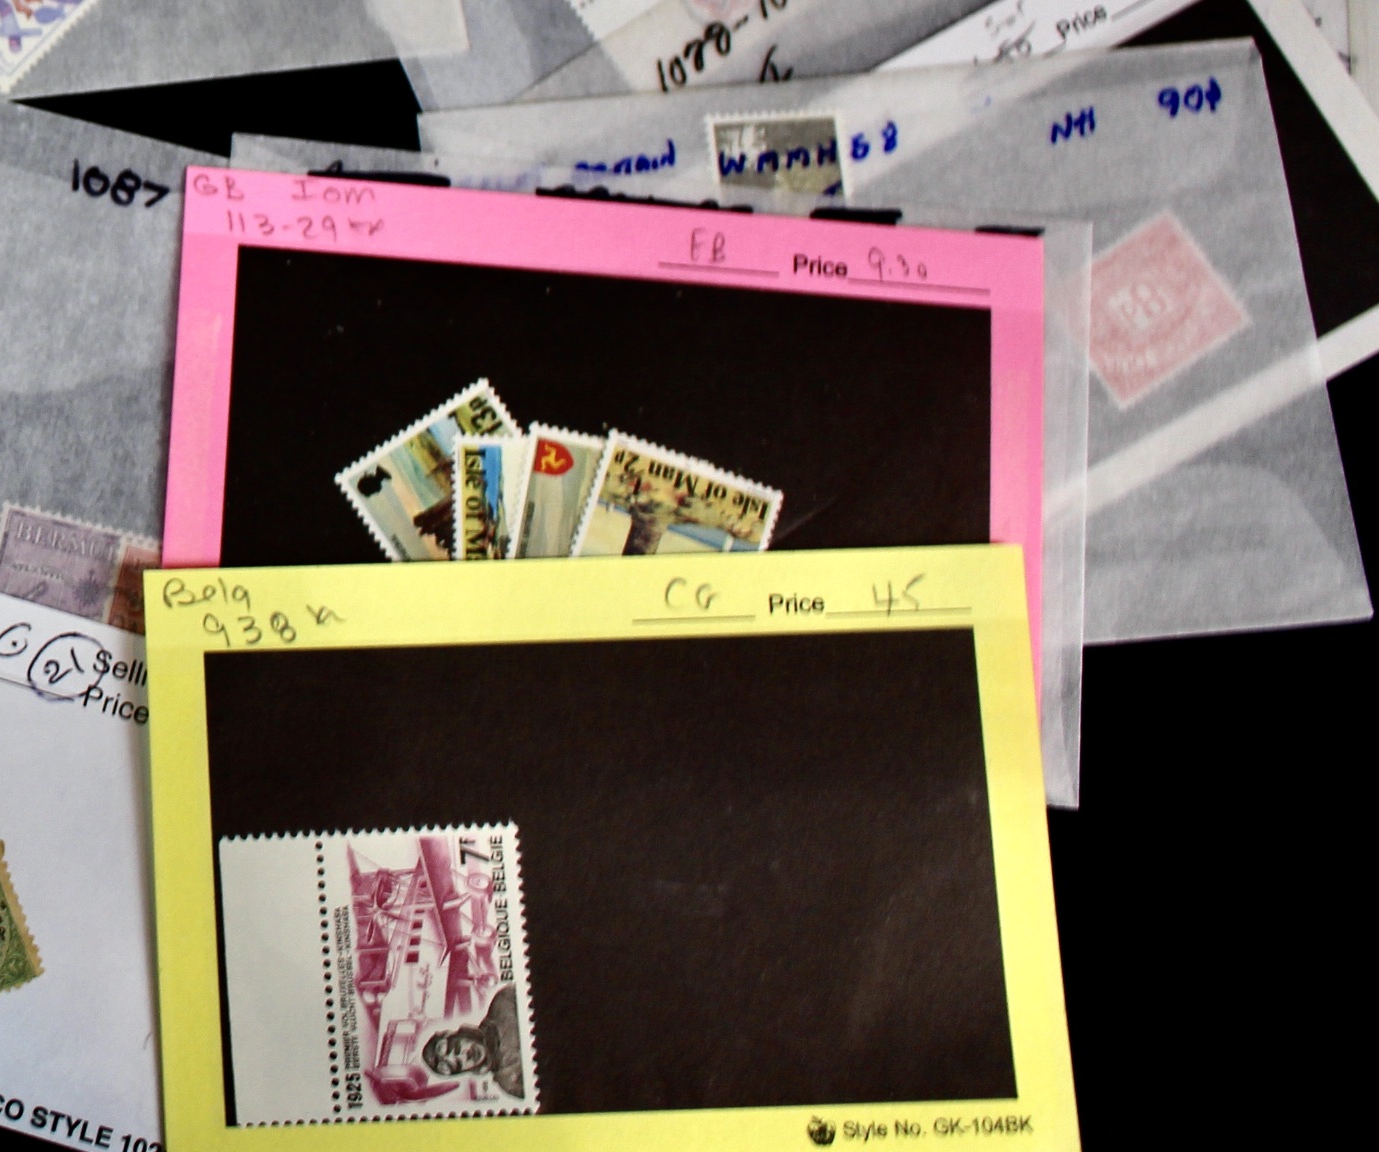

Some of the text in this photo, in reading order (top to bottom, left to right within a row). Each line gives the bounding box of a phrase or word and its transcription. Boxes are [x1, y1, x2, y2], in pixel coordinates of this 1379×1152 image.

[1055, 4, 1108, 44] Price
[792, 252, 849, 279] Price
[464, 448, 481, 489] Isle
[465, 495, 481, 521] of
[648, 457, 770, 521] Isle of Man
[768, 592, 826, 616] Price
[82, 684, 150, 725] Price
[493, 900, 514, 982] BELGIQUE
[345, 1072, 363, 1111] 1925
[29, 1105, 114, 1149] STYLE
[842, 1114, 1035, 1143] Style No. GK-104BK
